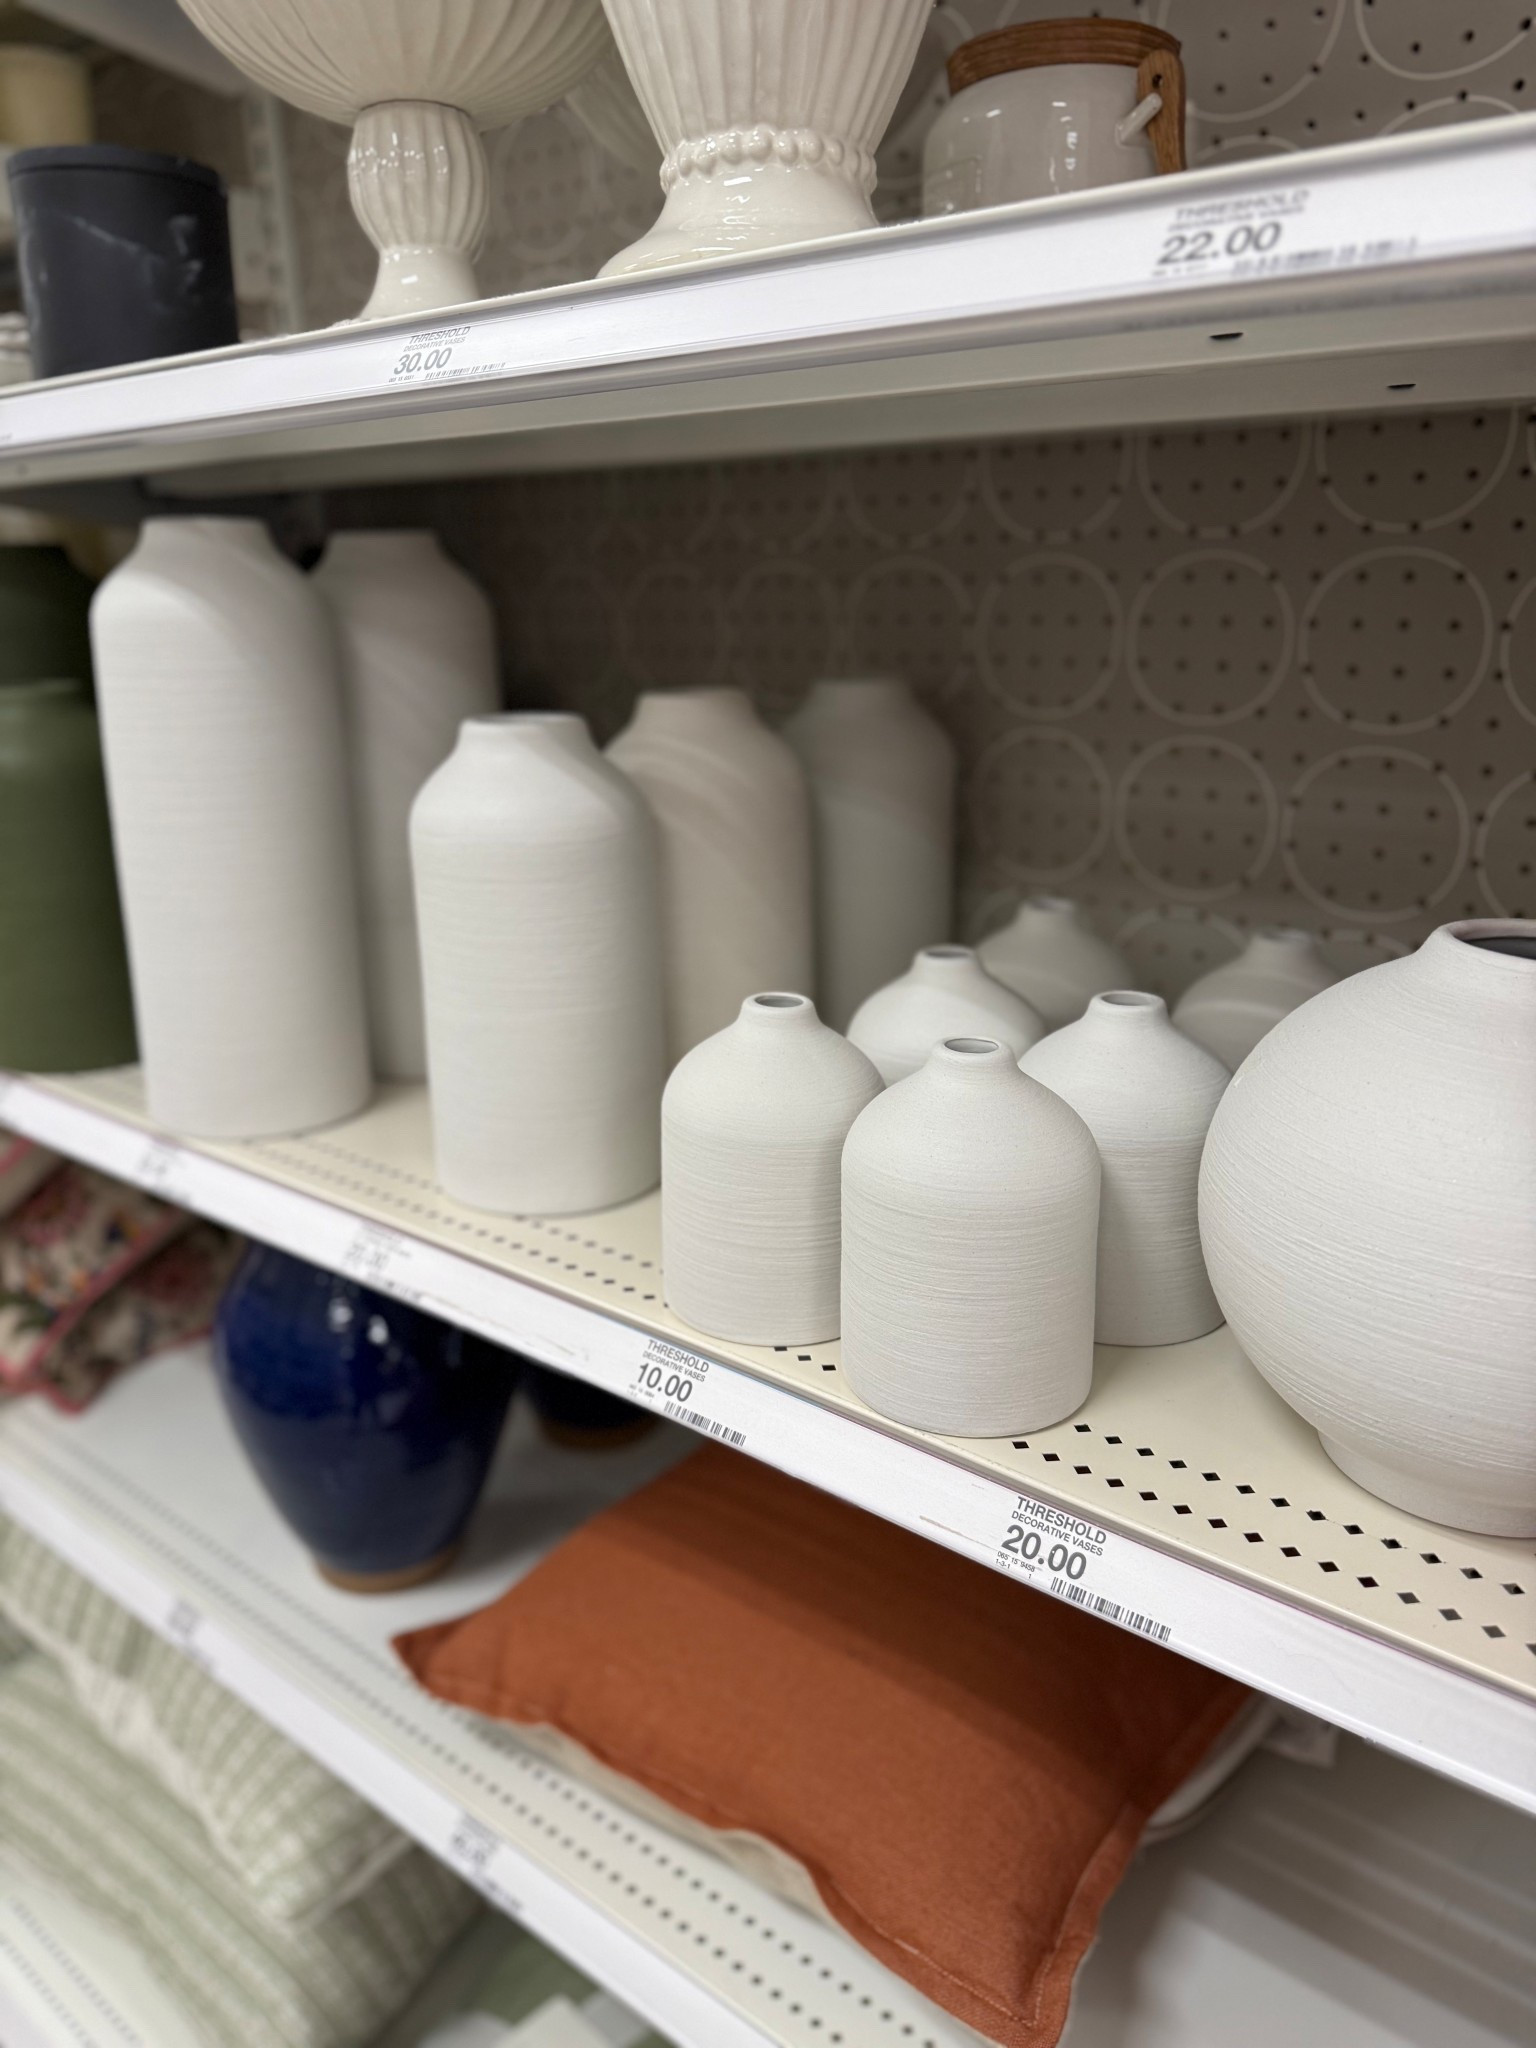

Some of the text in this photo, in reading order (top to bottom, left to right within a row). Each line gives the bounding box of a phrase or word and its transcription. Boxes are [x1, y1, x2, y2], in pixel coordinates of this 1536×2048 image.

[1157, 220, 1282, 266] 22.00
[403, 336, 466, 352] DECORATIVE VASES
[409, 326, 471, 344] THRESHOLD
[393, 347, 452, 375] 30.00
[642, 1351, 706, 1382] DECORATIVE VASES
[647, 1339, 709, 1373] THRESHOLD
[637, 1362, 693, 1402] 10.00
[1011, 1510, 1104, 1556] DECORATIVE VASES
[1017, 1496, 1106, 1545] THRESHOLD
[995, 1558, 1011, 1569] 1-3-1
[997, 1550, 1009, 1560] 065
[1011, 1557, 1018, 1565] 15
[1001, 1524, 1087, 1580] 20.00
